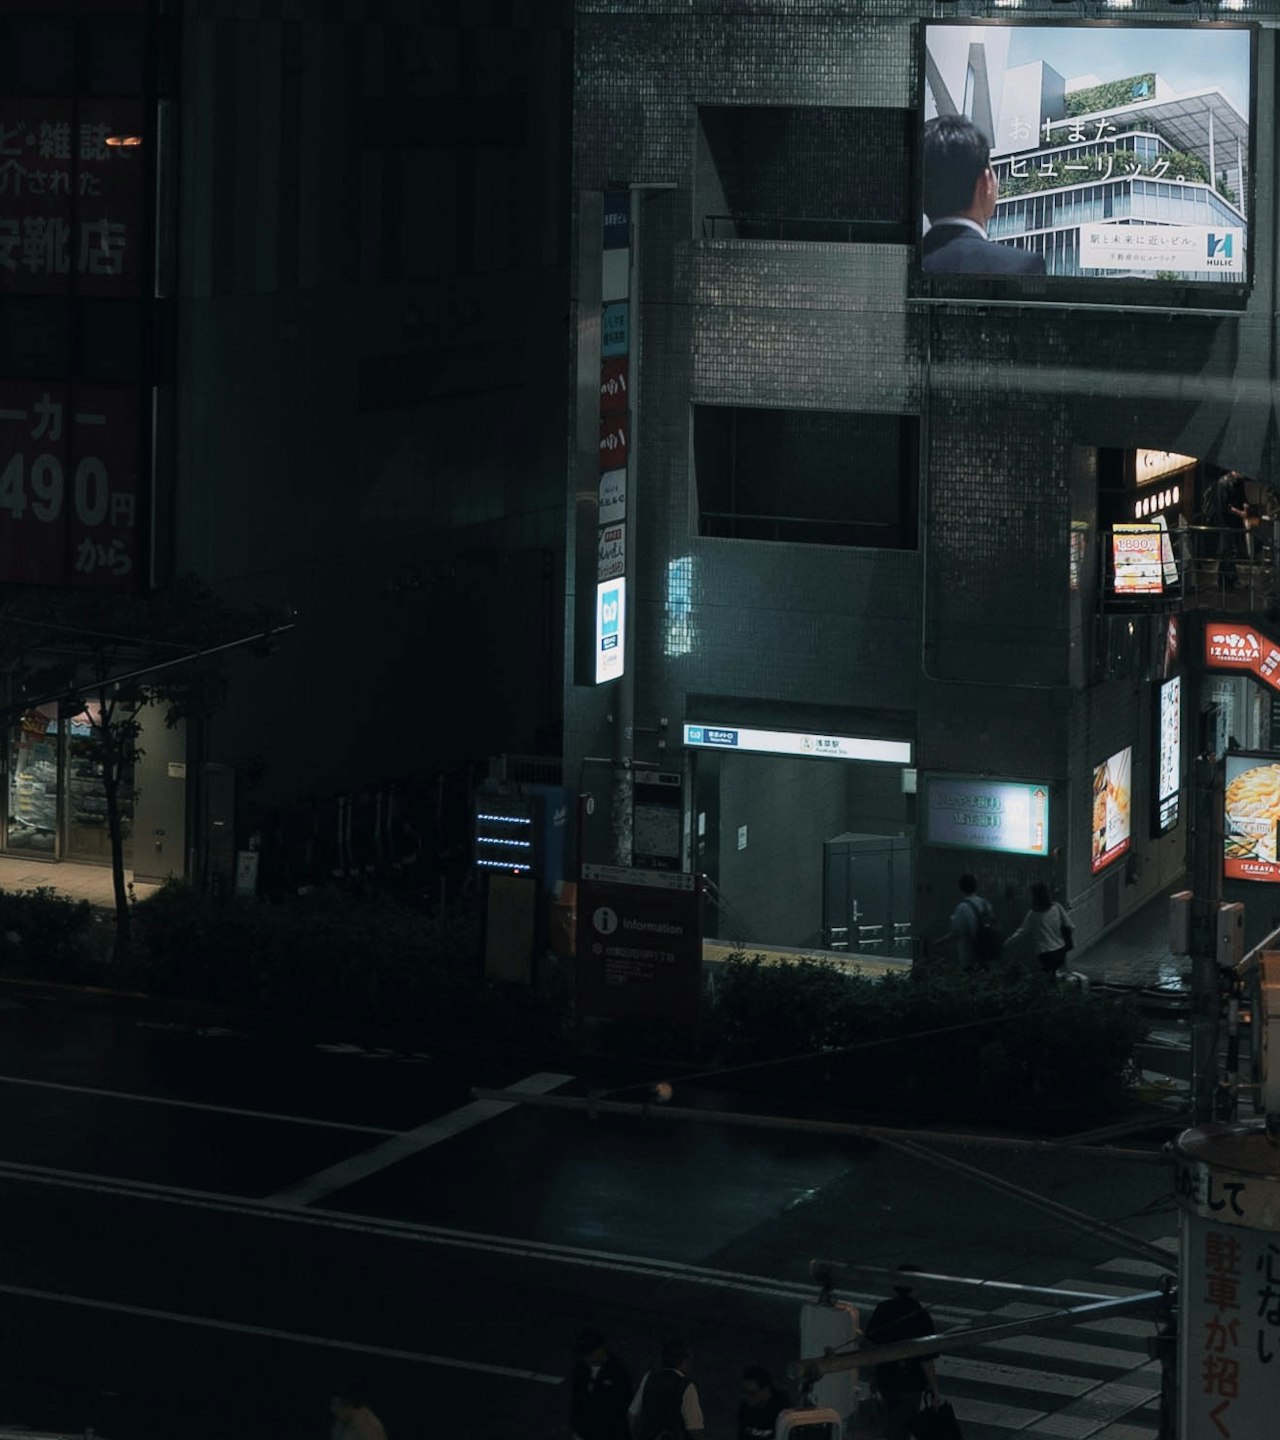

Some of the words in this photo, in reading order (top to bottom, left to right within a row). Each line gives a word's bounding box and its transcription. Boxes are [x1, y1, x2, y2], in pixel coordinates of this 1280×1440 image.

[1009, 155, 1186, 183] ヒューリック。
[74, 537, 133, 576] から
[1210, 646, 1260, 659] IZAKAYA
[622, 917, 683, 936] Information
[1201, 1231, 1241, 1440] 駐車が招く
